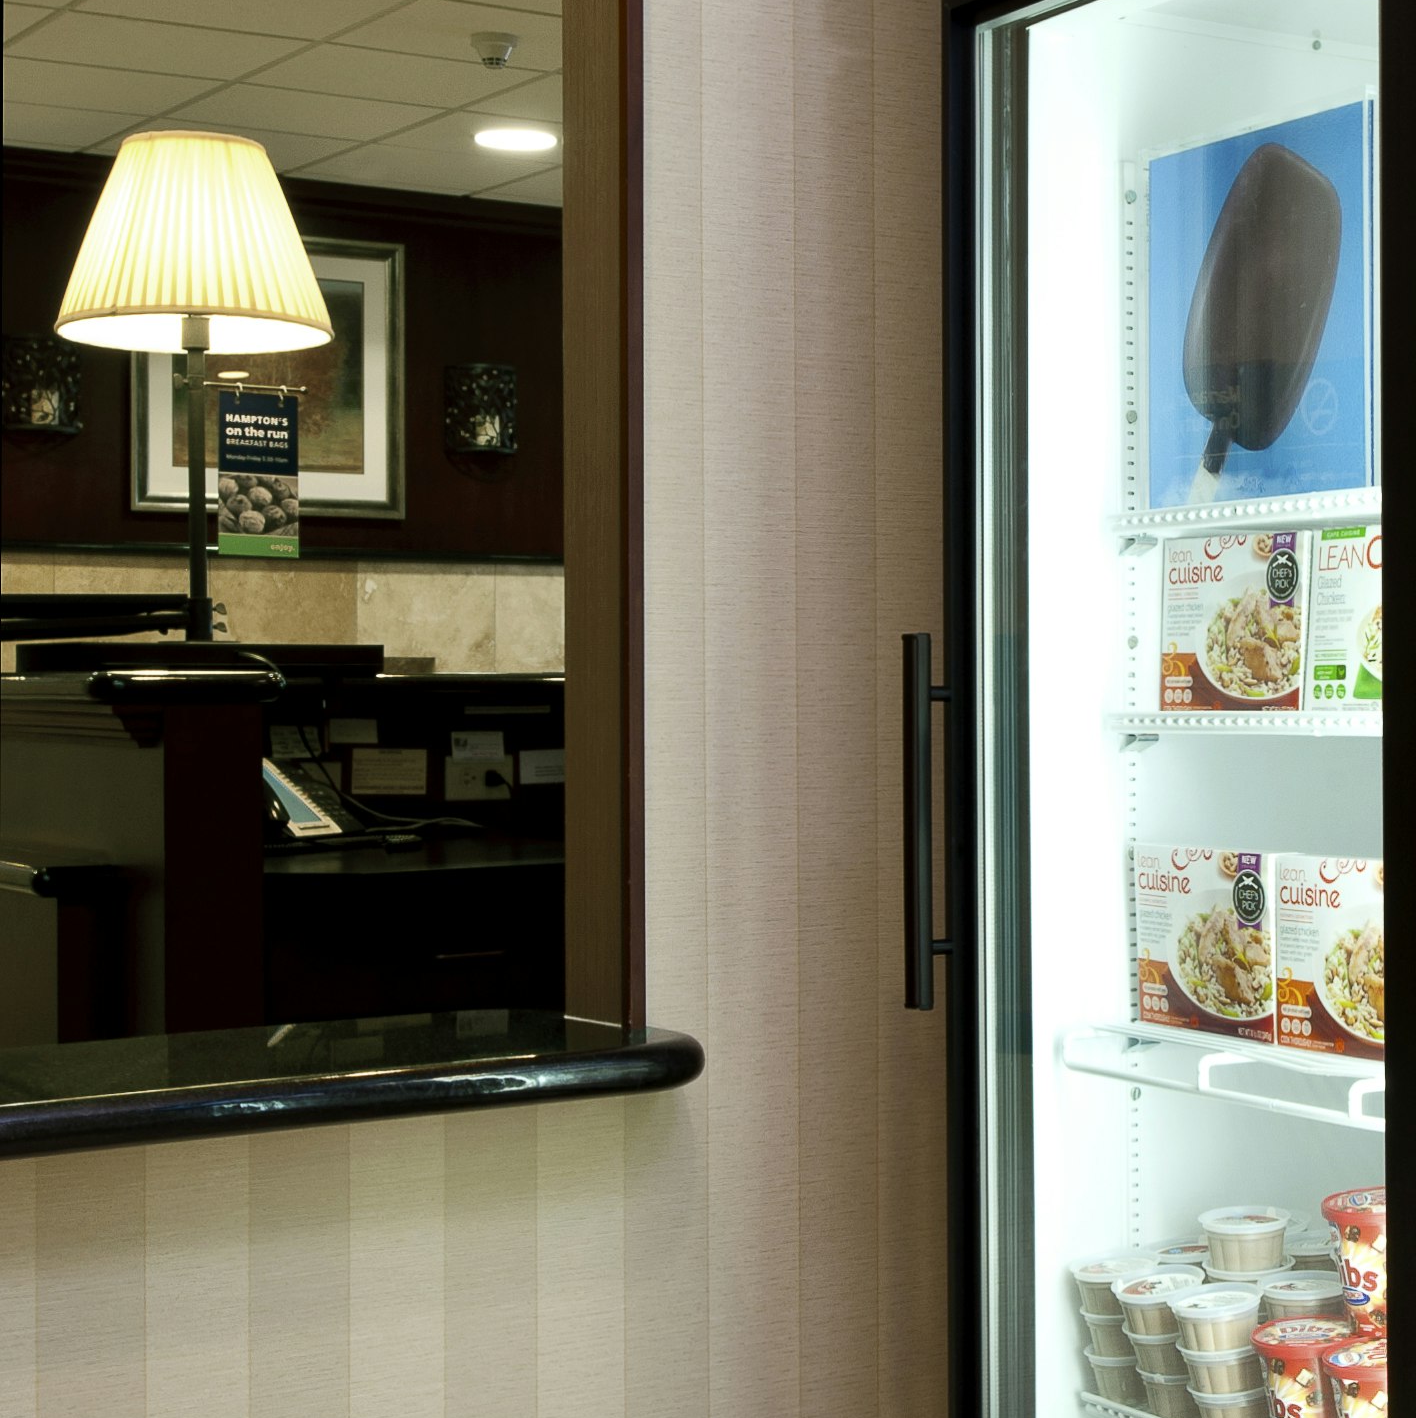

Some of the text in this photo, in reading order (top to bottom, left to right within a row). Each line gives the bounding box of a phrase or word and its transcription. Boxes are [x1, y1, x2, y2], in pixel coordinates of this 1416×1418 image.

[225, 413, 289, 427] HAMPTON'S
[225, 426, 289, 440] on the run
[268, 440, 289, 449] BAGS
[1276, 533, 1293, 544] NEW
[1318, 543, 1366, 571] LEAN
[1168, 563, 1224, 585] cuisine
[1241, 854, 1257, 865] NEW
[1138, 870, 1192, 895] cuisine
[1280, 882, 1341, 909] cuisine
